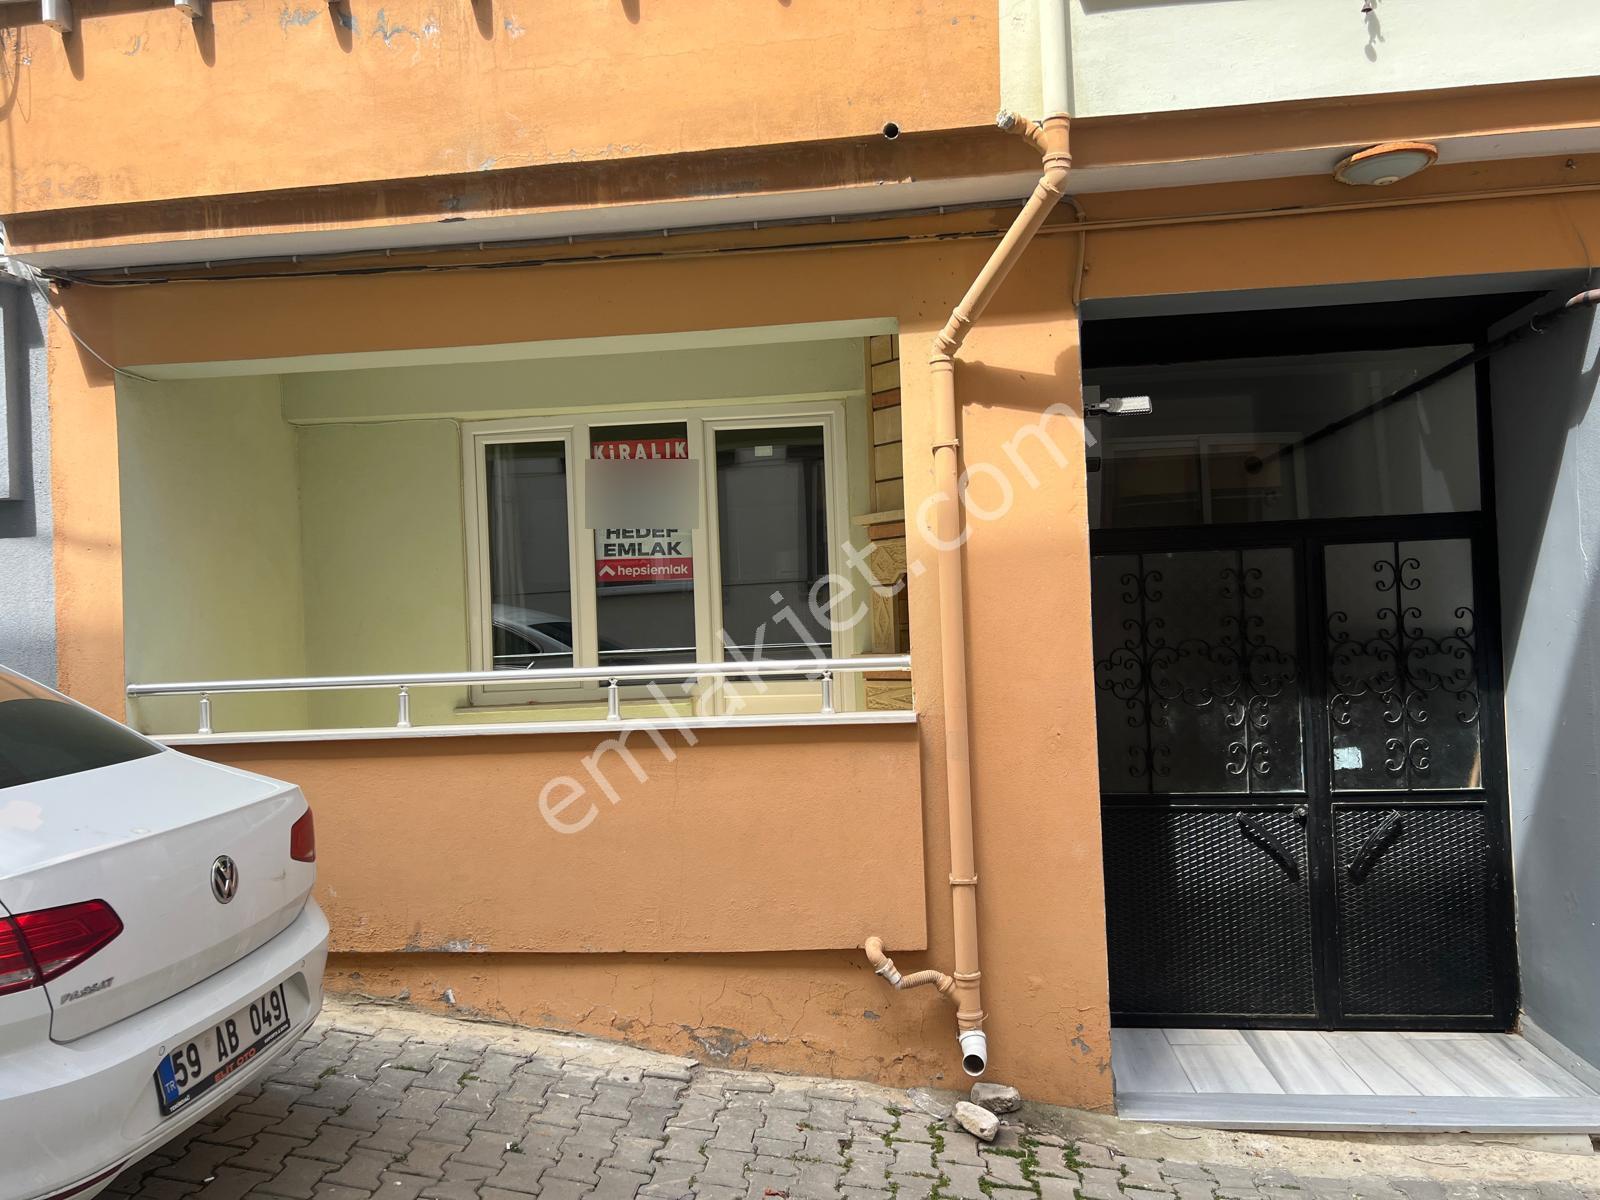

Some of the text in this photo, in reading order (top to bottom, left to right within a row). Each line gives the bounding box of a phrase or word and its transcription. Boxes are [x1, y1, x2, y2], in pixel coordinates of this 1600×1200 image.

[603, 541, 682, 557] EMLAK
[617, 564, 689, 577] hepsiemlak
[172, 1042, 202, 1088] 59
[215, 1018, 240, 1062] AB
[249, 990, 281, 1036] 049
[236, 1047, 257, 1067] OTO
[165, 1080, 177, 1093] TR
